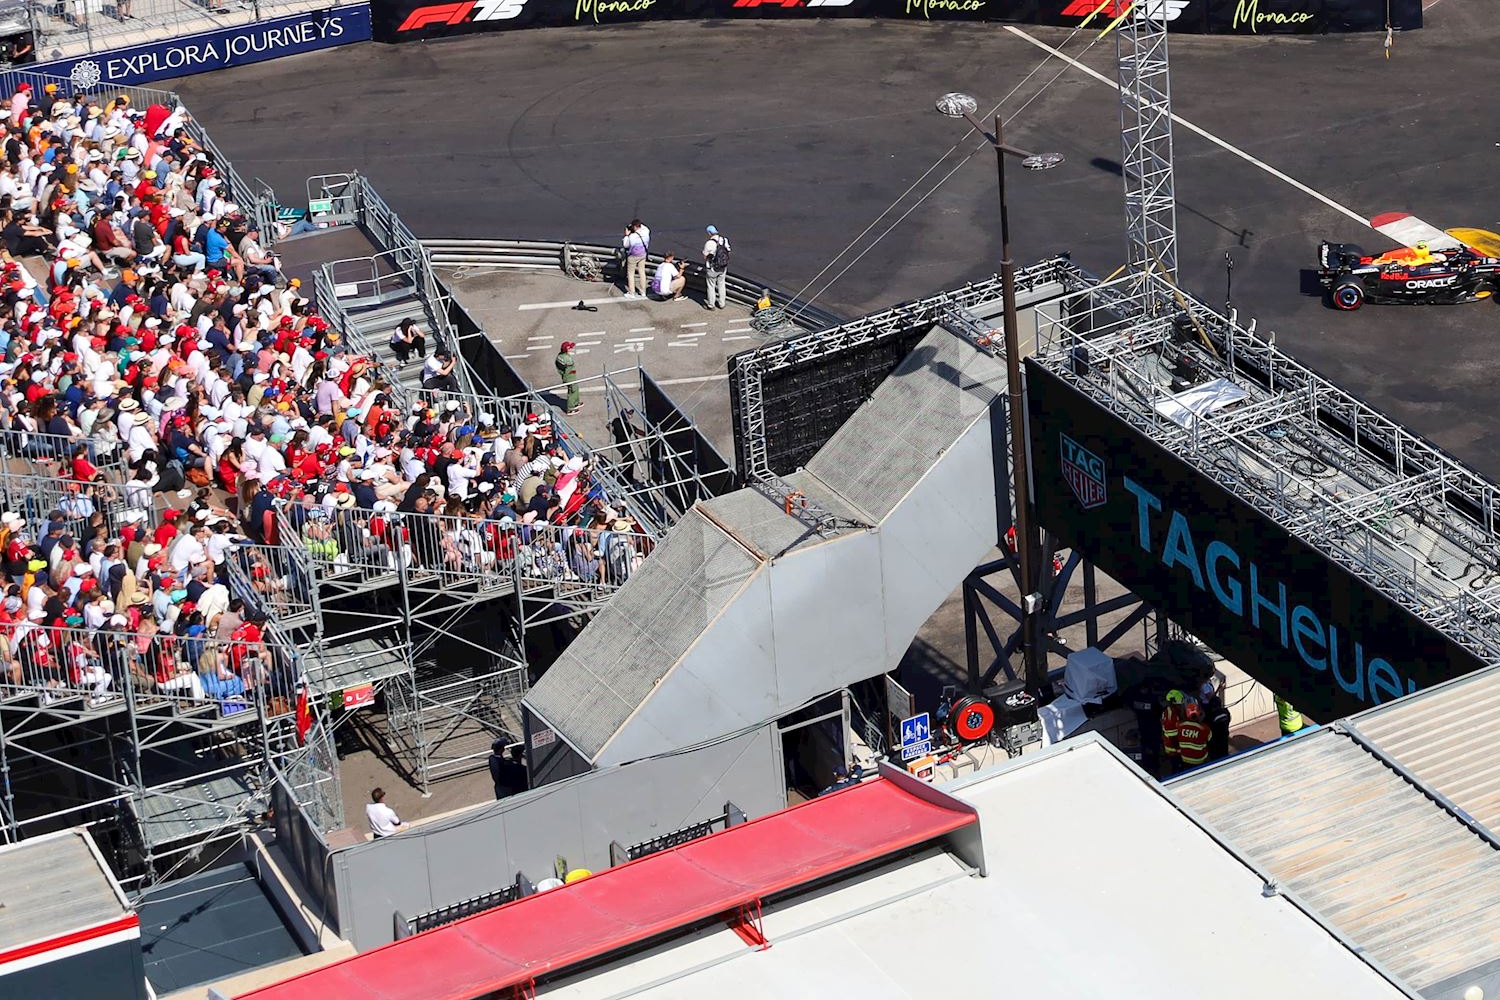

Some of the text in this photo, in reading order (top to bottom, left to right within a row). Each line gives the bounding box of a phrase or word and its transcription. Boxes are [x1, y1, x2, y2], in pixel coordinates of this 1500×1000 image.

[222, 17, 344, 63] JOURNEYS
[1406, 275, 1457, 289] ORACLE
[1063, 439, 1102, 482] TAG
[1063, 462, 1105, 505] HEUER
